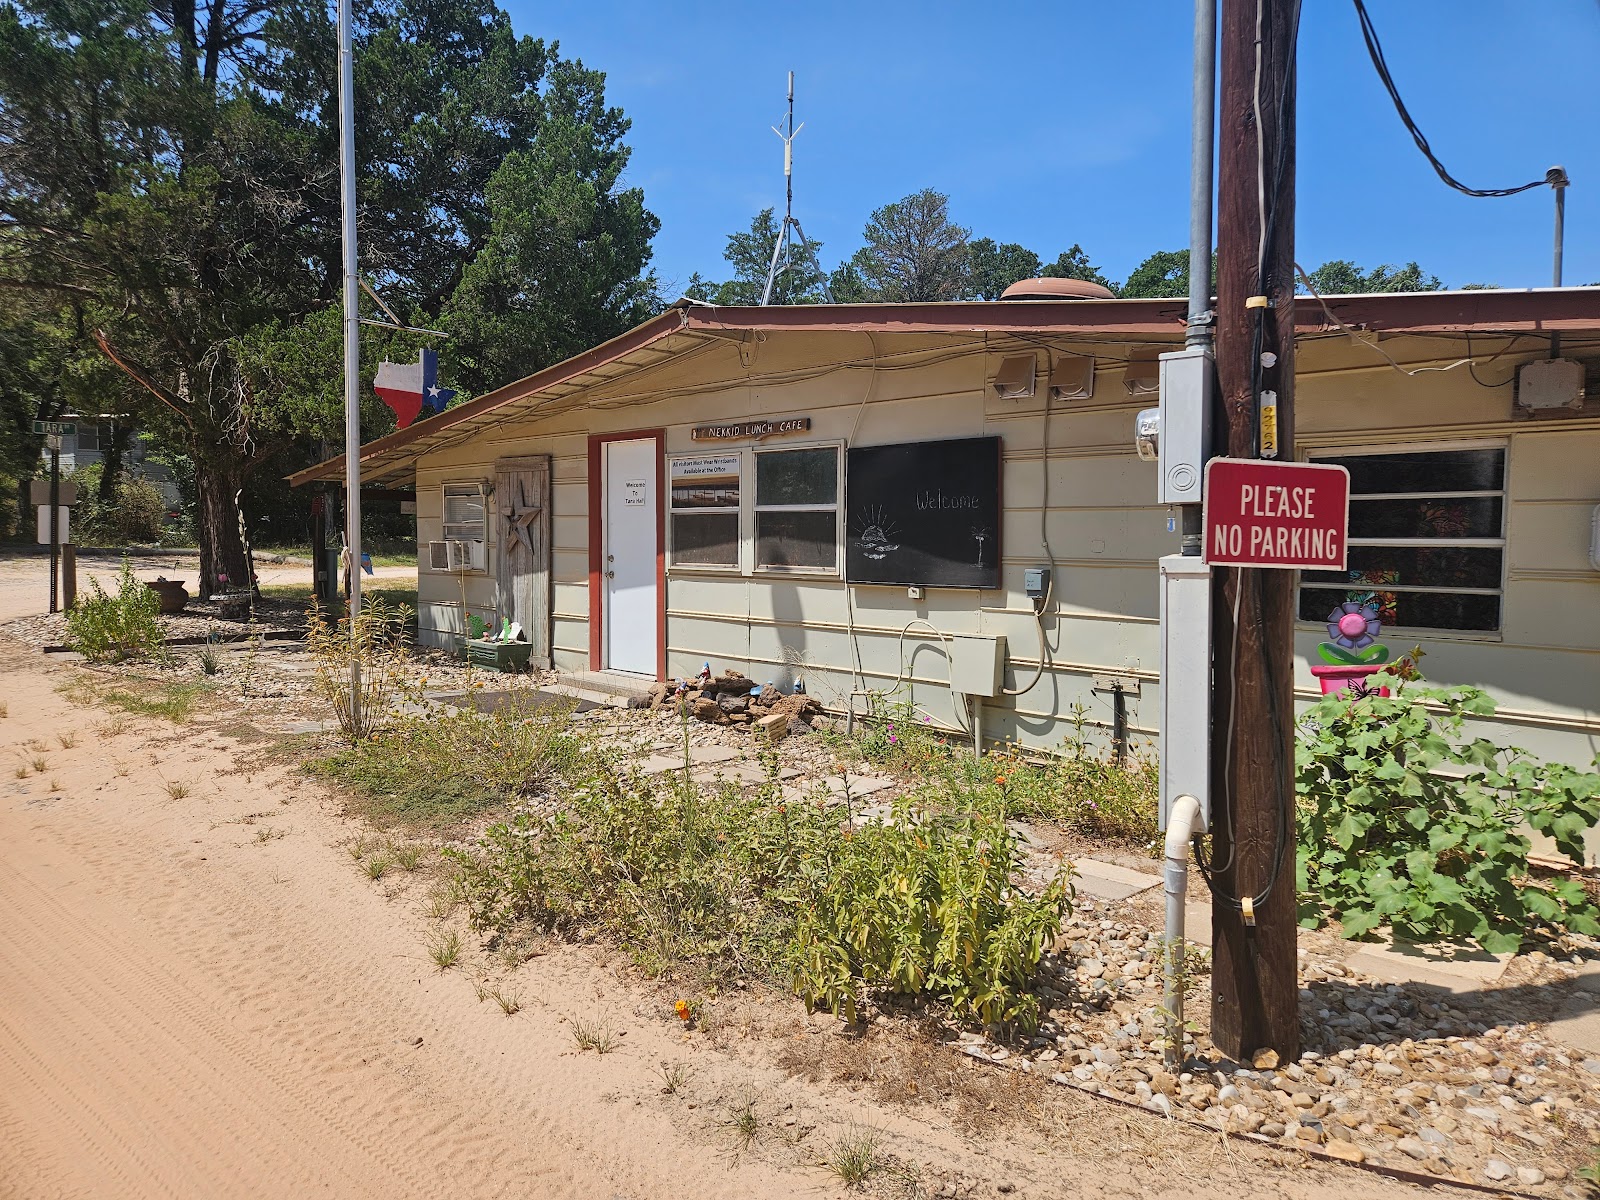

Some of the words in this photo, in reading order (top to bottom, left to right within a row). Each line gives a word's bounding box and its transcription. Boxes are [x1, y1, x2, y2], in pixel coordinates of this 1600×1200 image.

[41, 422, 64, 433] TARA
[708, 426, 740, 437] NEKKID
[745, 423, 773, 435] LUNCH
[780, 420, 802, 431] CAFE
[916, 488, 979, 510] Welcome
[1240, 484, 1316, 519] PLEASE
[1214, 524, 1242, 556] NO
[1250, 526, 1338, 560] PARKING
